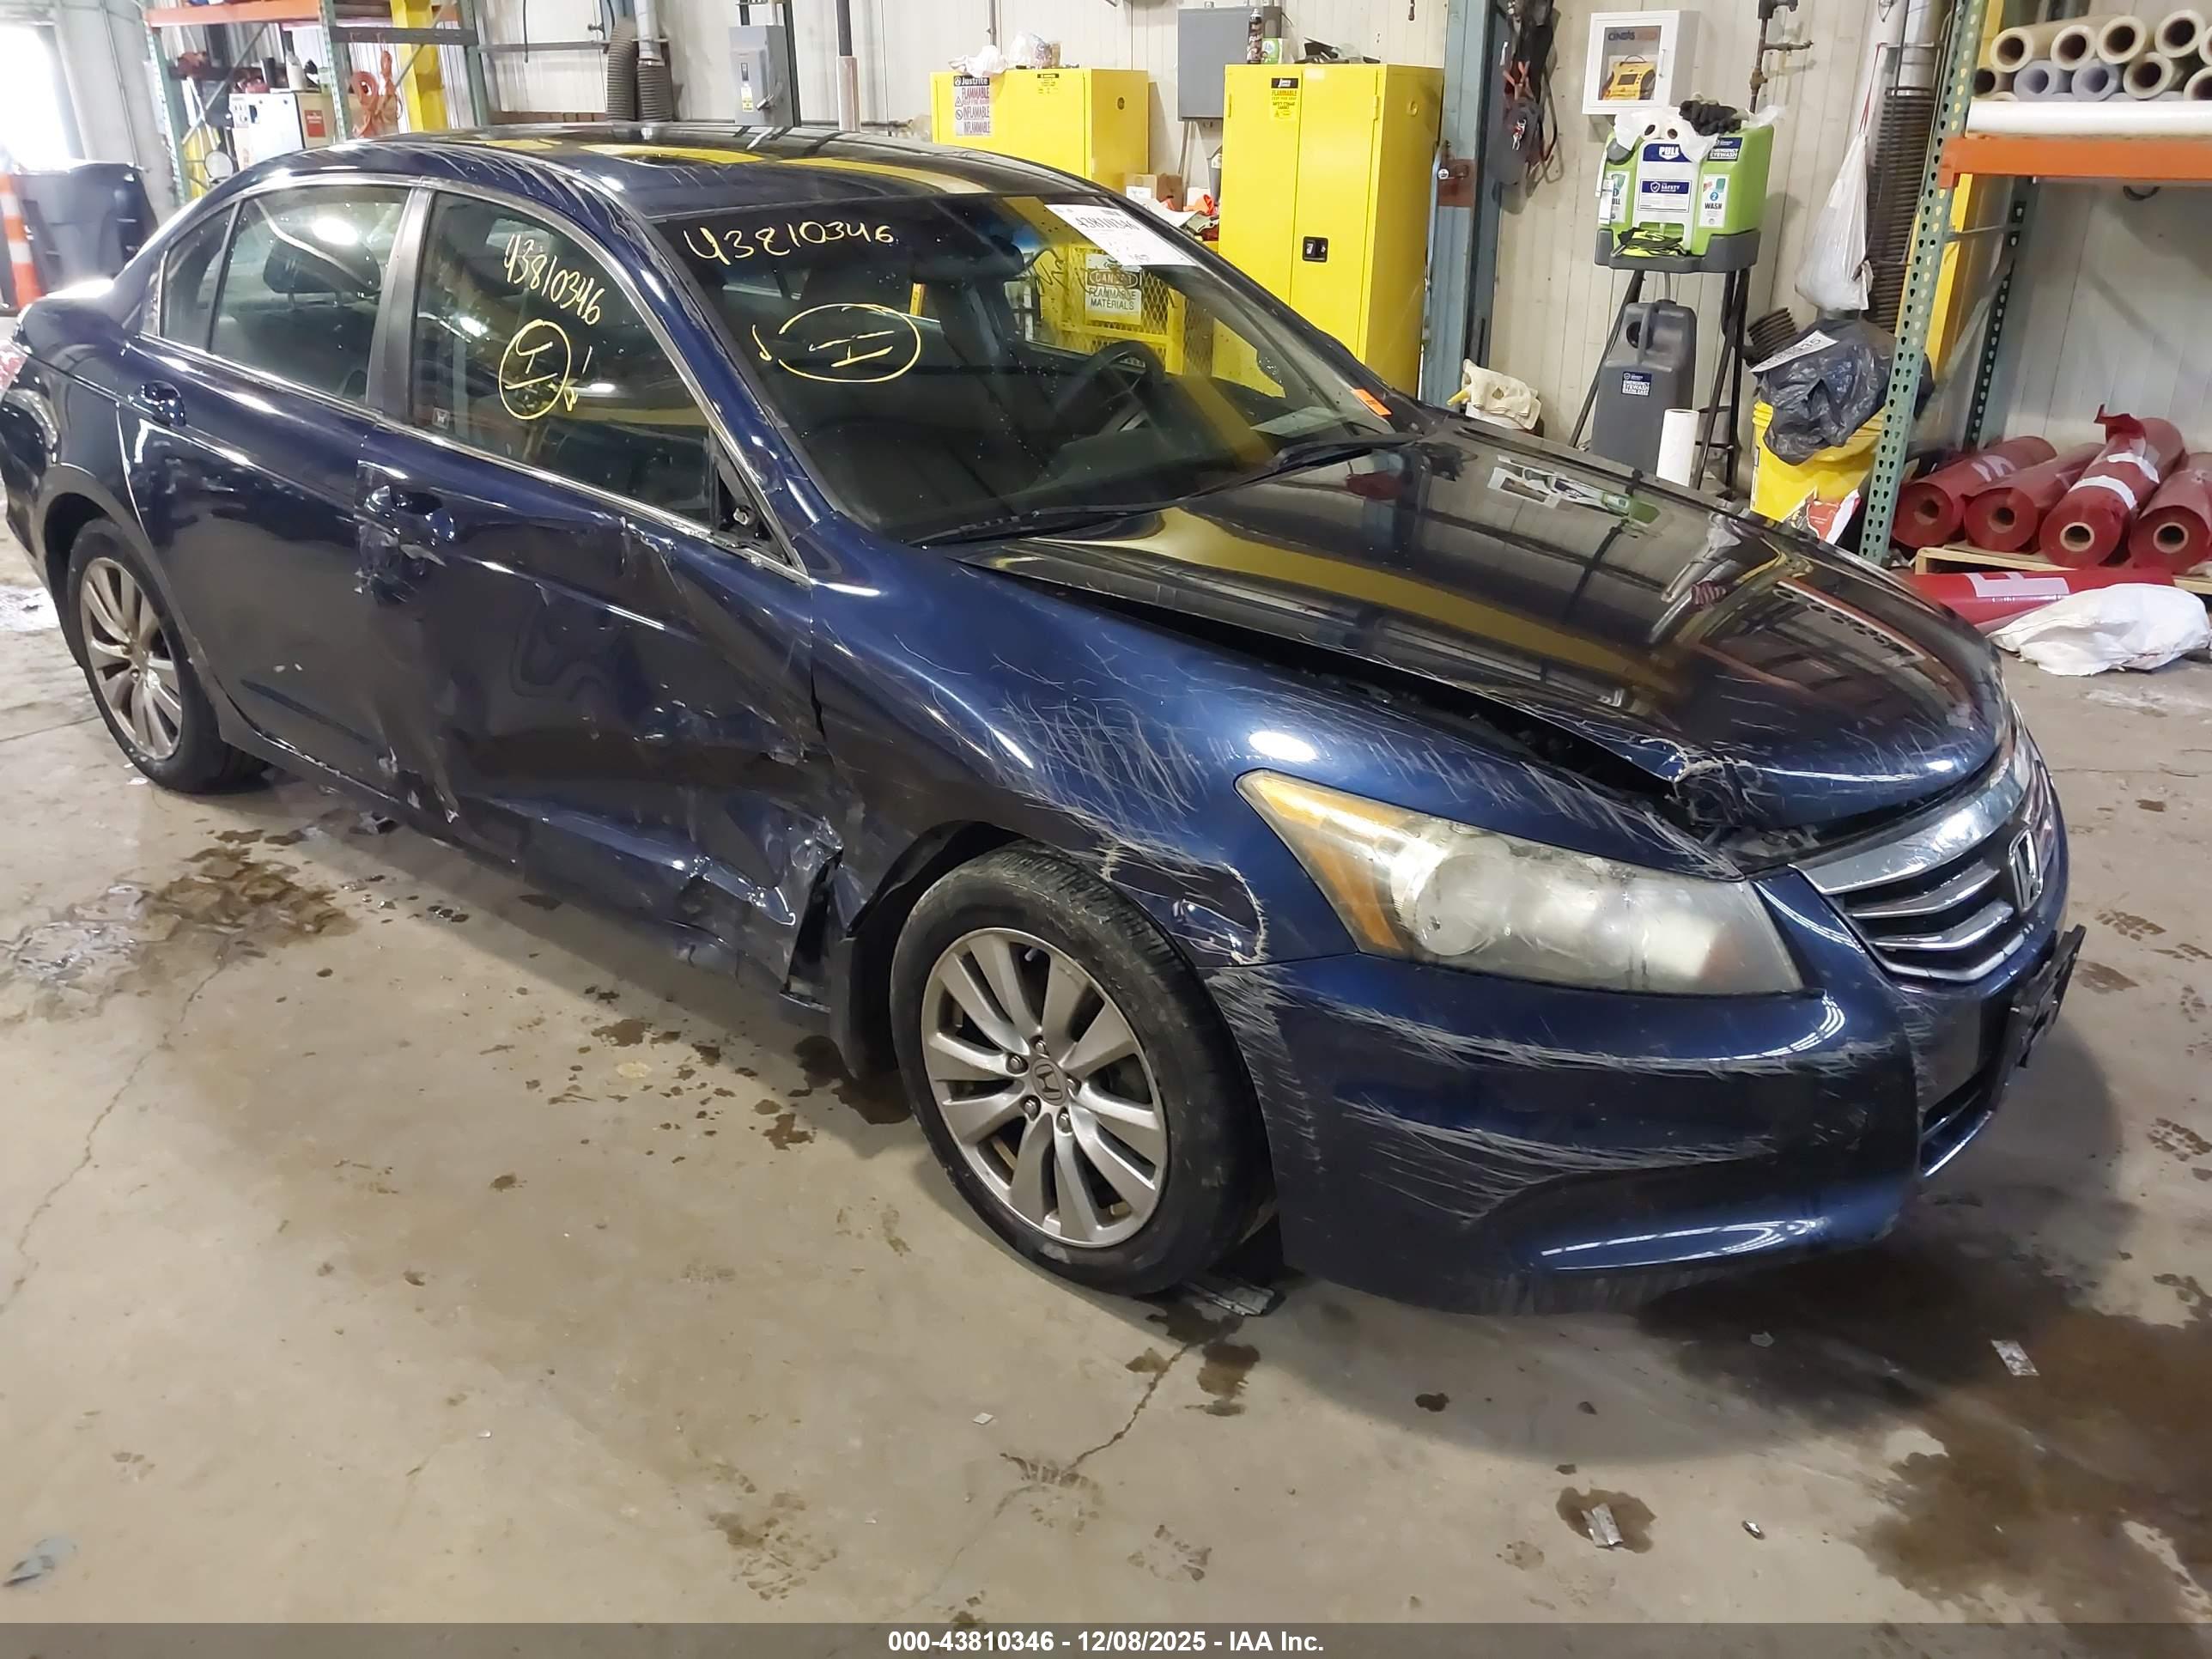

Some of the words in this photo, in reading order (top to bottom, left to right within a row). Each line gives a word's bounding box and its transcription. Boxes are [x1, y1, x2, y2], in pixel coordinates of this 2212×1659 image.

[962, 88, 989, 100] FLAMMABLE
[504, 234, 605, 325] 43810346
[1091, 296, 1134, 310] MATERIALS
